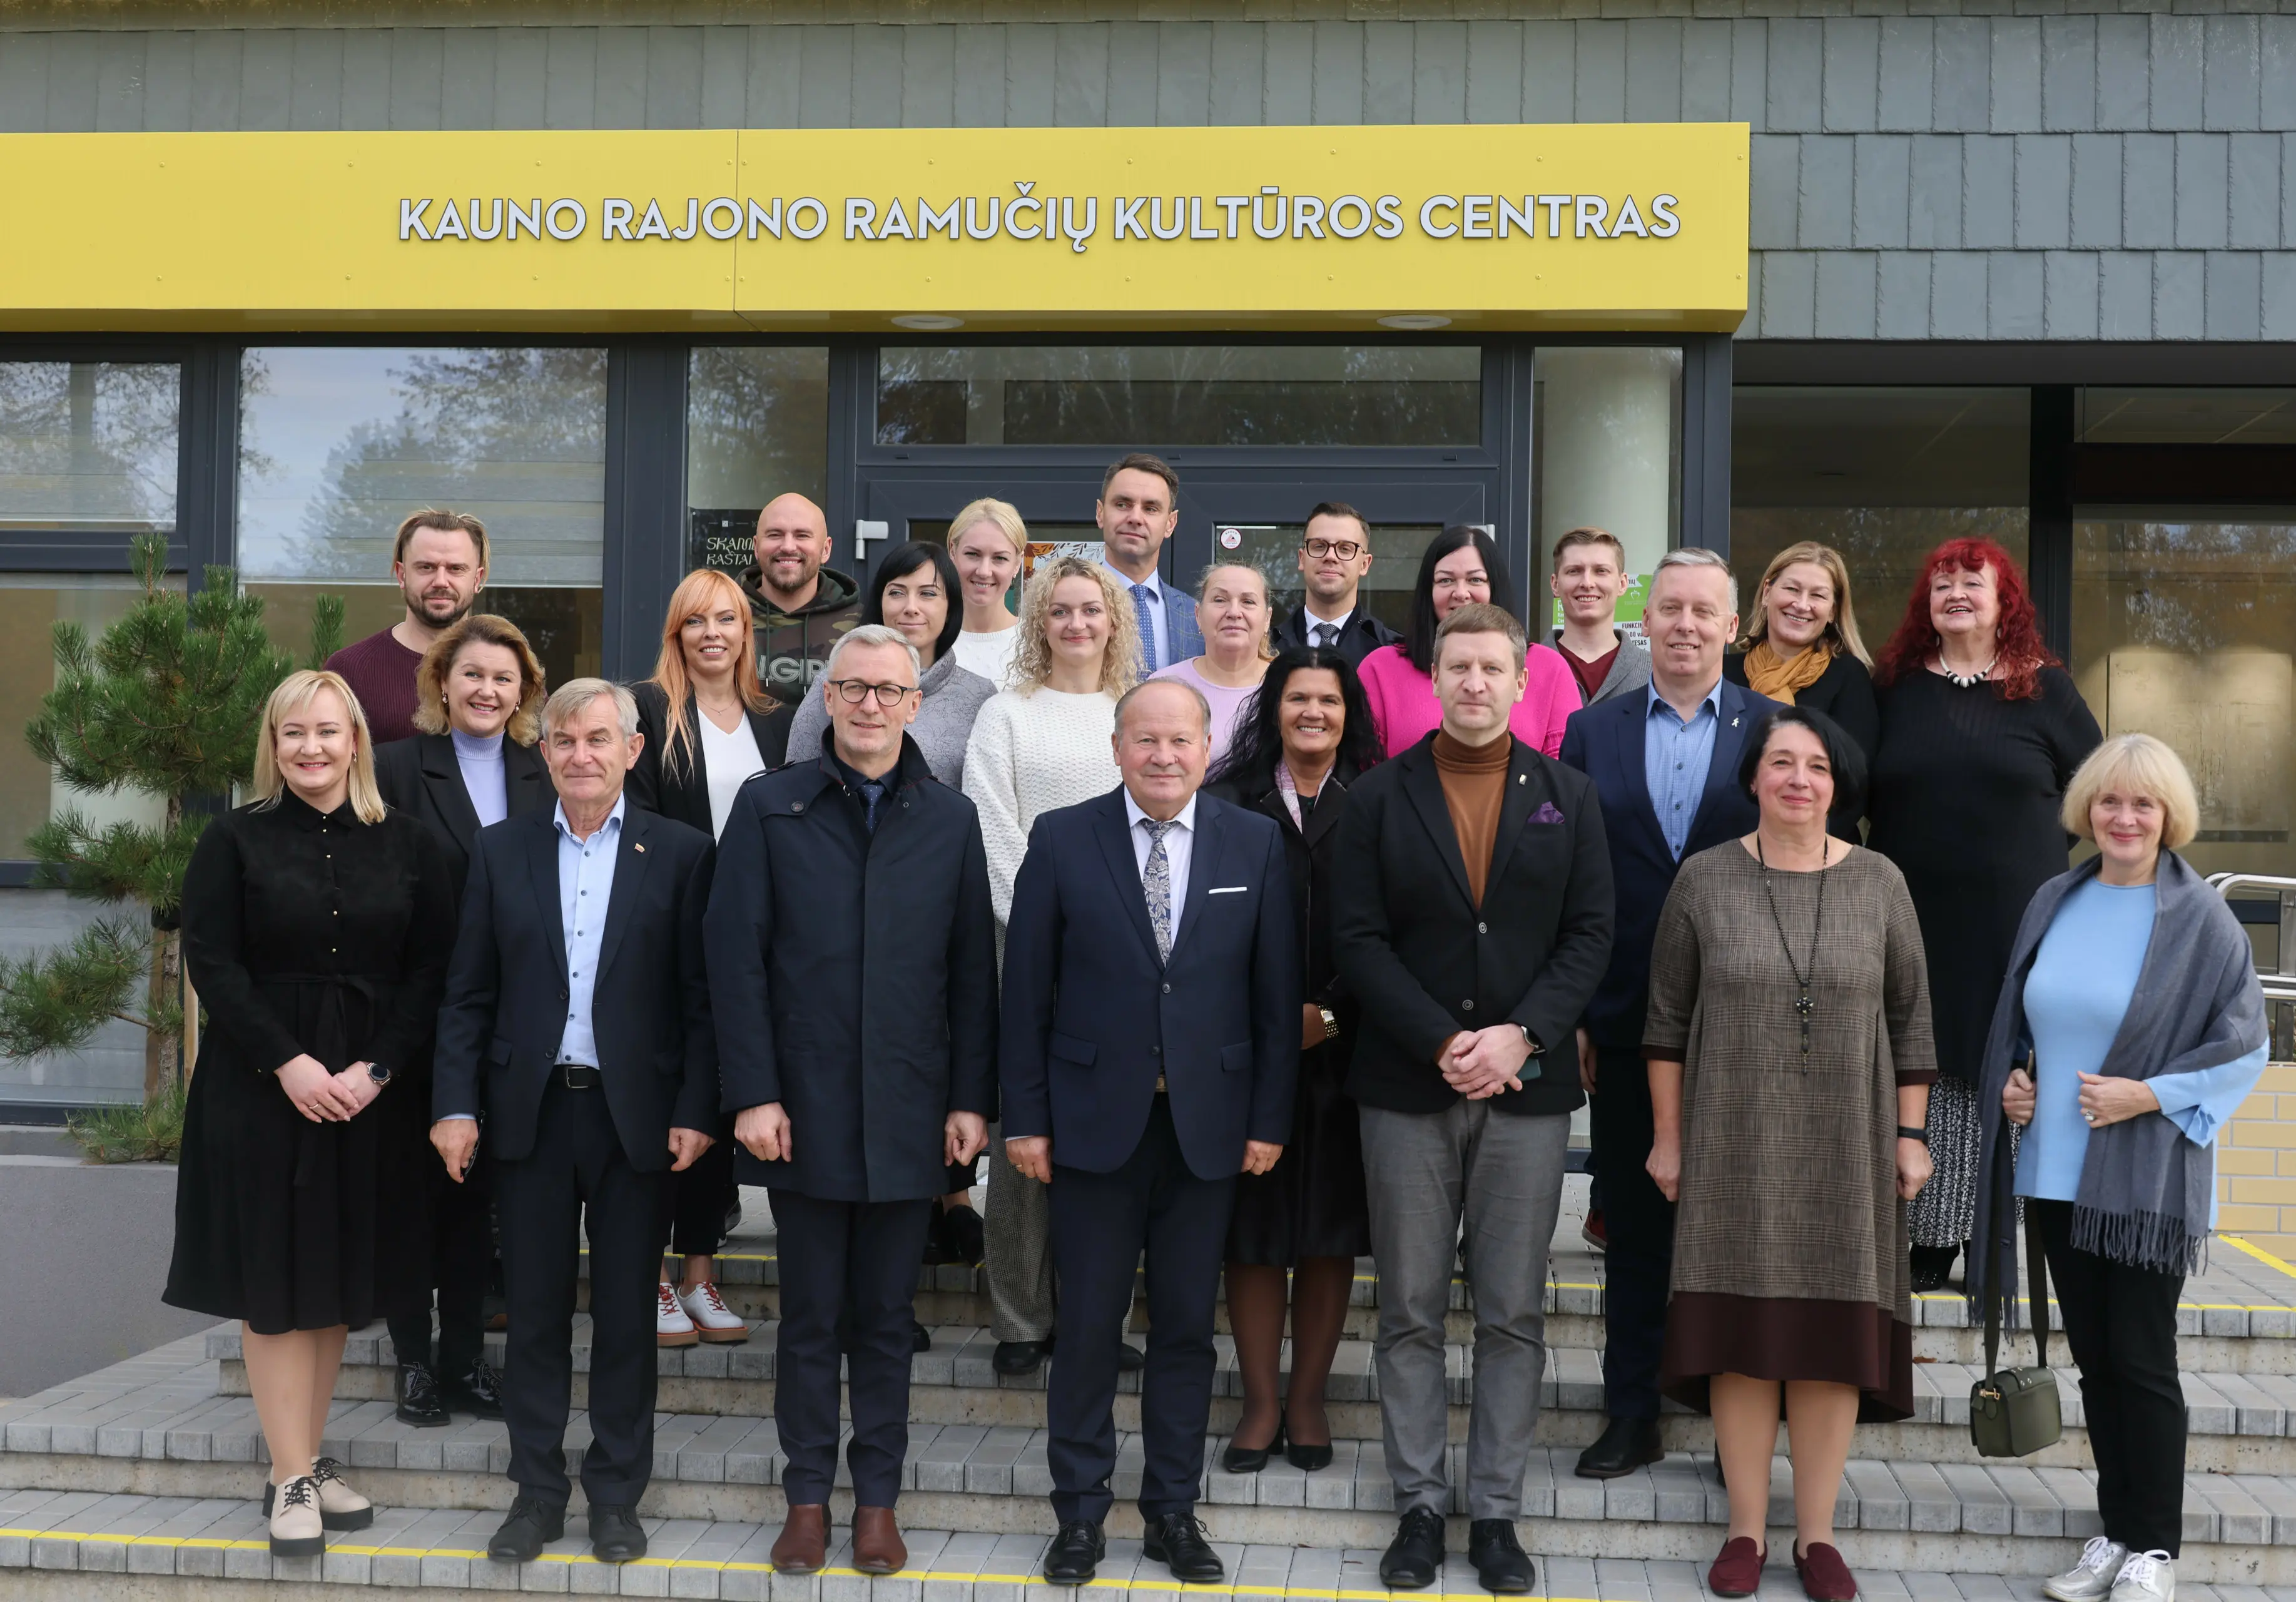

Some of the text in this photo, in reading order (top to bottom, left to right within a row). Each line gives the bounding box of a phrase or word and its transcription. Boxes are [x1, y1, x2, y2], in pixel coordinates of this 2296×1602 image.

[399, 181, 1681, 253] KAUNO RAJONO RAMUČIŲ KULTŪROS CENTRAS
[756, 655, 829, 685] LGIR
